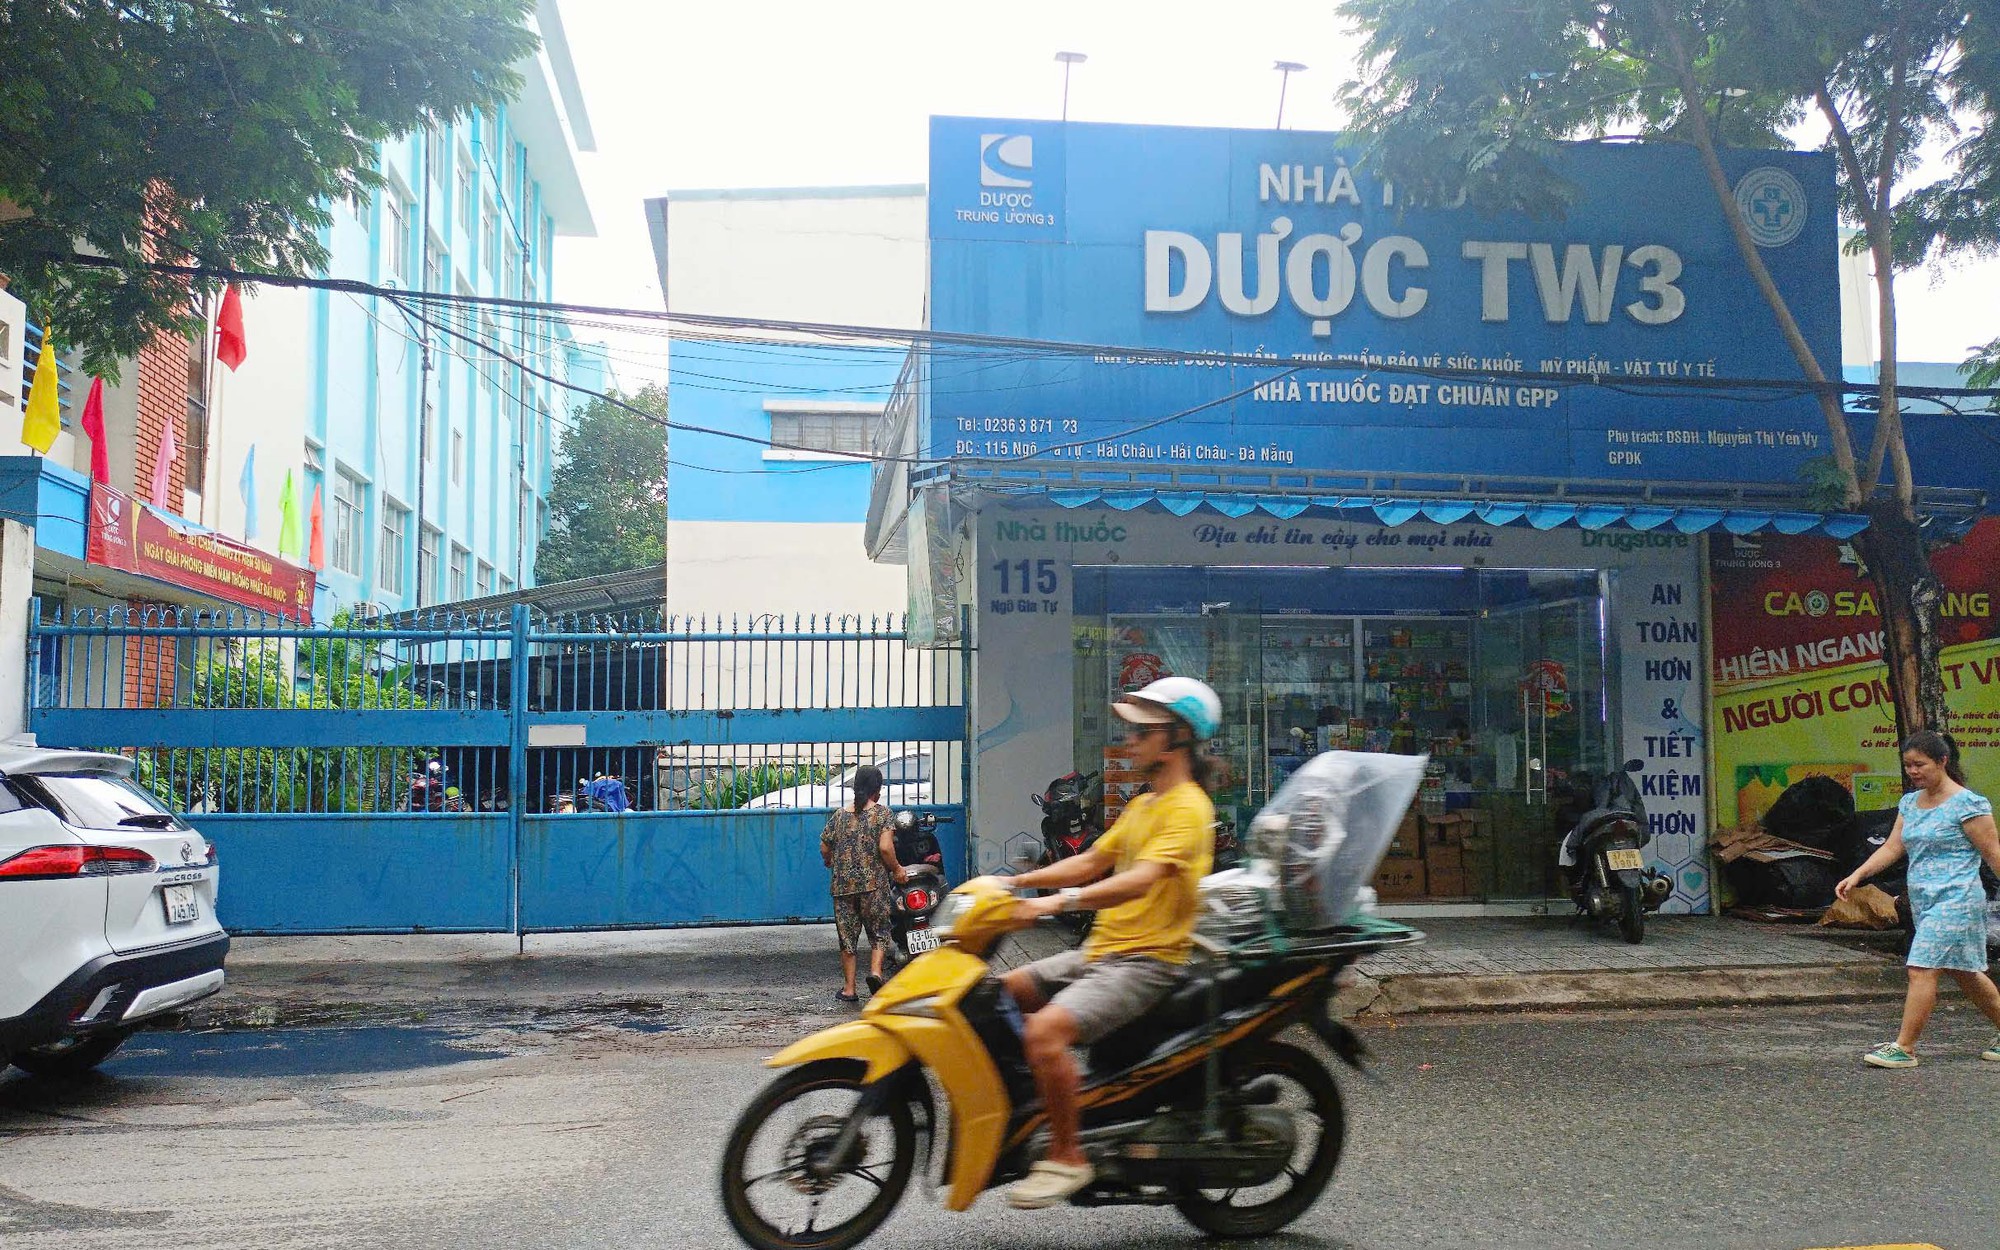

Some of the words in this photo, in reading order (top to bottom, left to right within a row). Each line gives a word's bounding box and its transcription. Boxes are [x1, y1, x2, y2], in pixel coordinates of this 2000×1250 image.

[1260, 157, 1361, 206] NHÀ
[980, 191, 1032, 212] DƯỢC
[956, 209, 999, 222] TRUNG
[1005, 212, 1045, 225] ƯƠNG
[1047, 214, 1055, 225] 3
[1144, 216, 1429, 337] DƯỢC
[1462, 241, 1686, 325] TW3
[1541, 357, 1563, 374] MỸ
[1567, 353, 1611, 376] PHẨM
[1697, 358, 1717, 378] TẾ
[1253, 375, 1301, 403] NHÀ
[1307, 374, 1382, 404] THUỐC
[1389, 384, 1431, 410] ĐẠT
[1438, 377, 1511, 408] CHUẨN
[1516, 387, 1559, 409] GPP
[985, 418, 1015, 432] 0236
[1019, 418, 1026, 433] 3
[1030, 419, 1053, 433] 871
[985, 441, 1008, 455] 115
[1196, 444, 1227, 460] Châu
[1239, 444, 1256, 462] Đà
[996, 517, 1046, 542] Nhà
[1055, 513, 1128, 543] thuốc
[1193, 523, 1237, 549] Địa
[1244, 524, 1278, 545] chỉ
[1284, 526, 1314, 545] tin
[1321, 525, 1359, 551] cậy
[1365, 527, 1403, 547] cho
[1407, 529, 1448, 552] mọi
[1452, 528, 1495, 548] nhà
[1582, 529, 1689, 552] Drugstore
[144, 540, 165, 562] NGÀY
[993, 558, 1058, 595] 115
[1651, 583, 1682, 606] AN
[1636, 614, 1698, 644] TOÀN
[1645, 656, 1692, 682] HƠN
[1661, 697, 1679, 721] &
[1722, 688, 1826, 733] NGƯỜI
[1644, 728, 1696, 758] TIẾT
[1642, 771, 1702, 802] KIỆM
[1650, 809, 1696, 835] HƠN
[174, 873, 203, 881] CROSS
